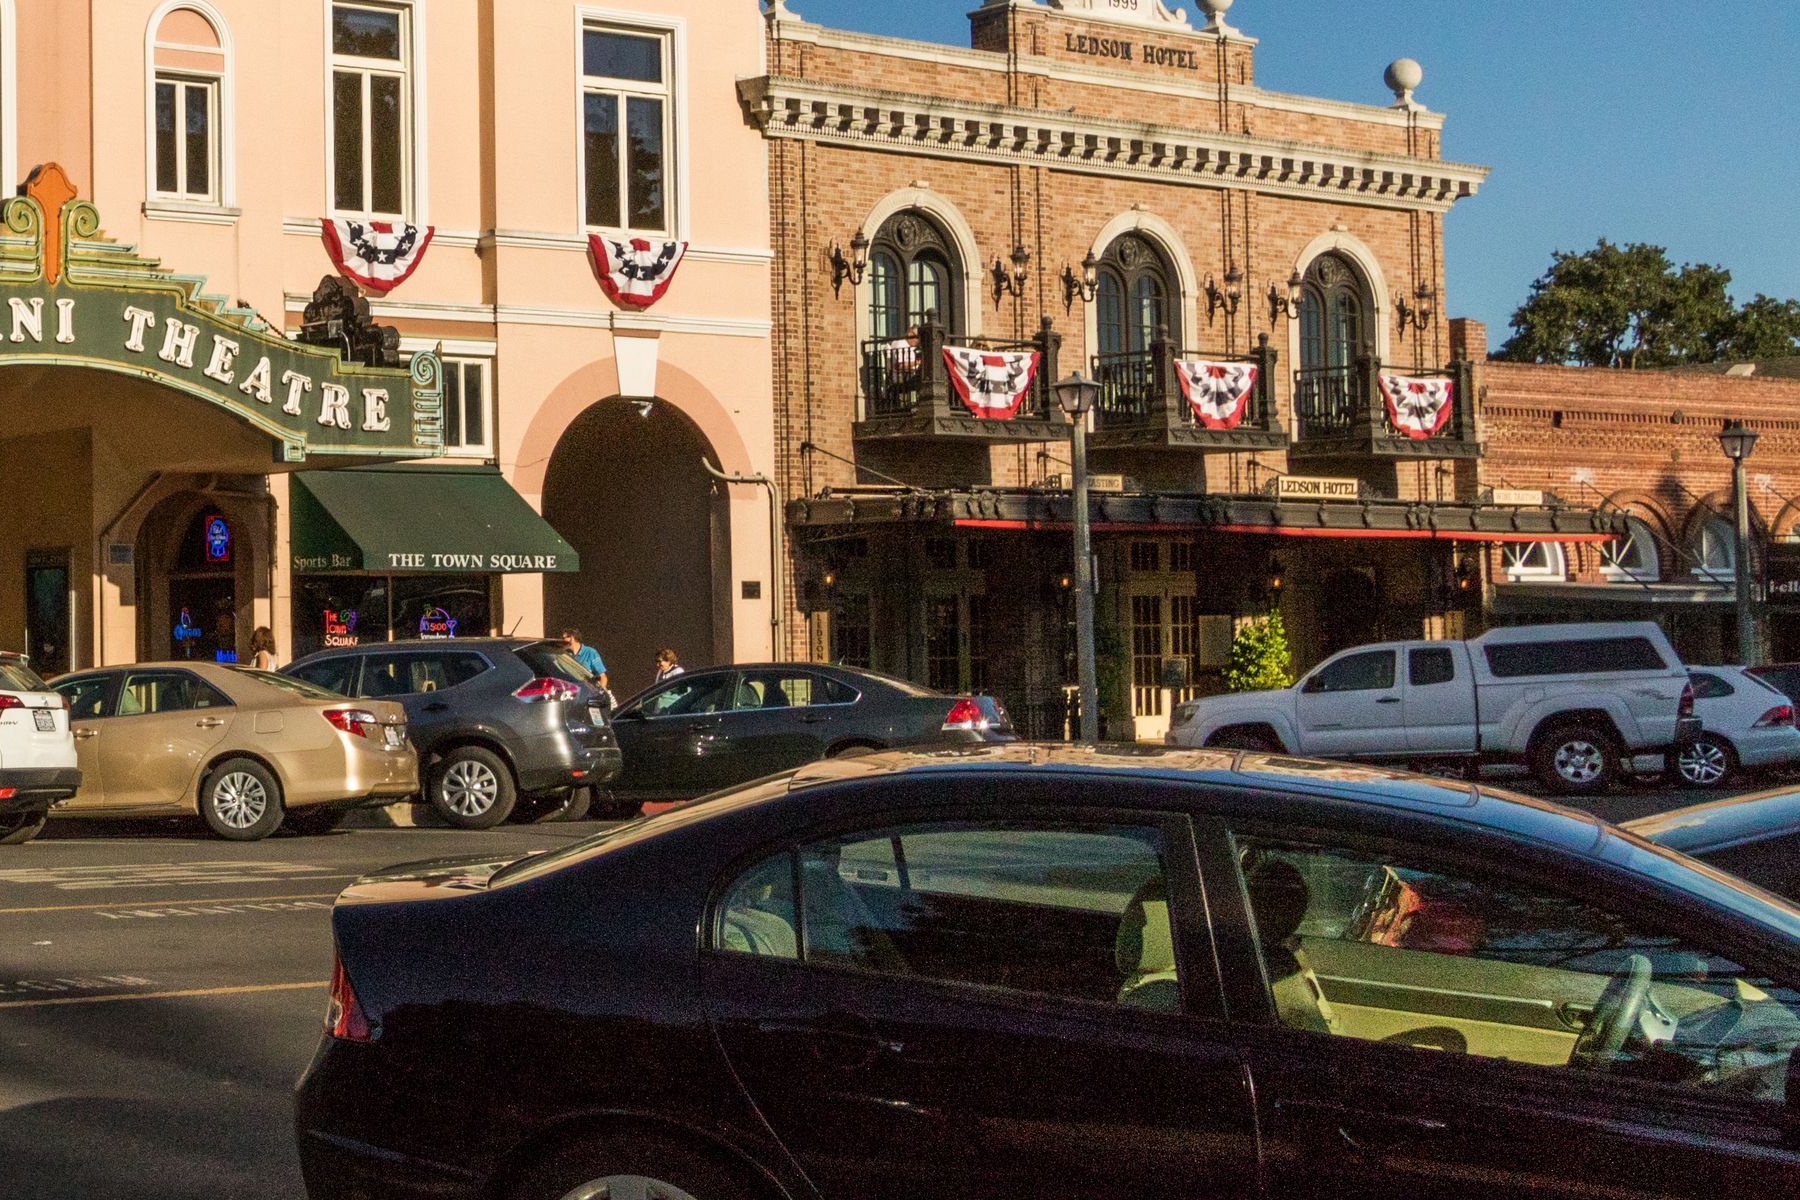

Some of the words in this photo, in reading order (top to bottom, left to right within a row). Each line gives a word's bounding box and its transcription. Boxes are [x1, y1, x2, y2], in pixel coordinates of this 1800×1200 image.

[1065, 32, 1133, 60] LEDSON
[1143, 44, 1199, 70] HOTEL
[123, 304, 391, 433] THEATRE
[1280, 479, 1321, 494] LEDSON
[1323, 481, 1357, 495] HOTEL
[294, 555, 327, 569] Sports
[331, 553, 351, 568] Bar
[389, 553, 425, 568] THE
[431, 554, 483, 568] TOWN
[490, 554, 557, 569] SQUARE
[816, 613, 824, 660] LEDSON
